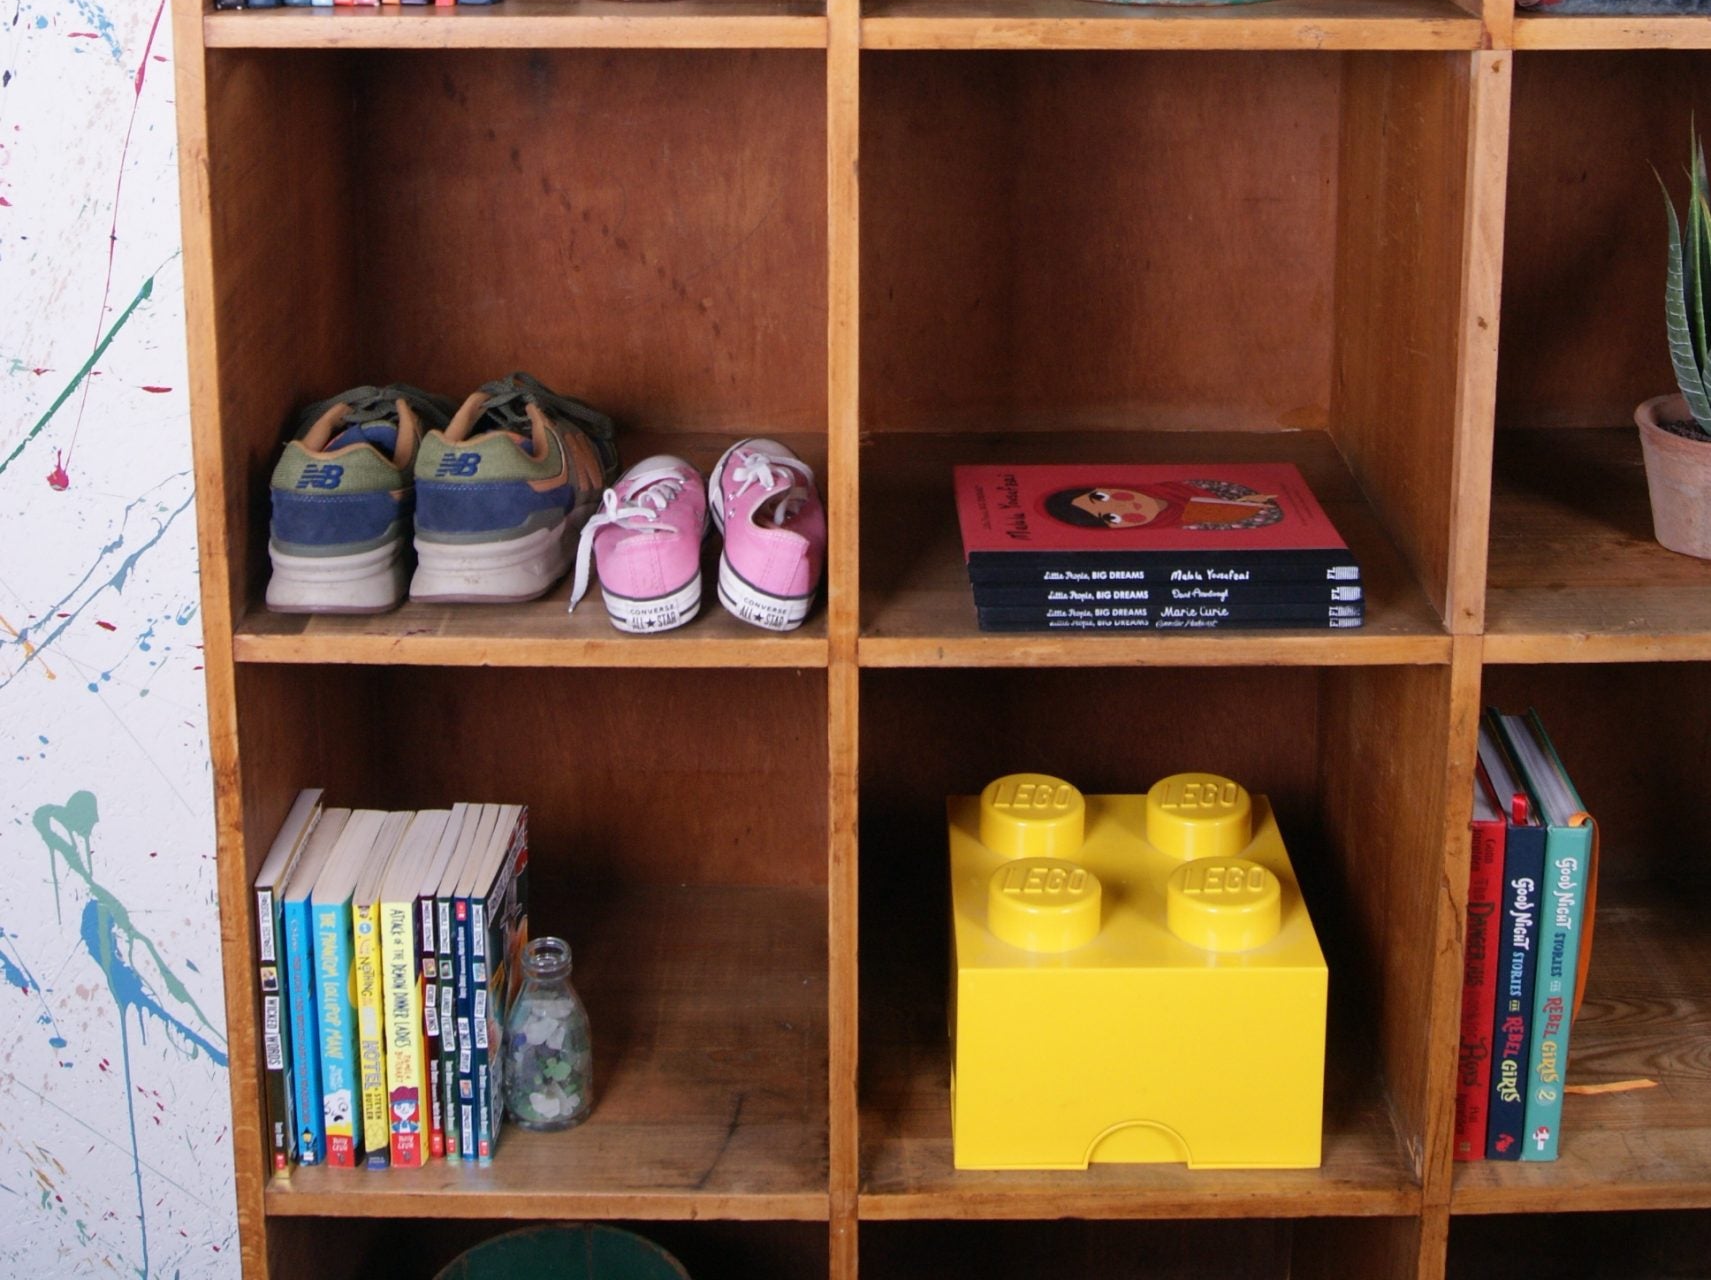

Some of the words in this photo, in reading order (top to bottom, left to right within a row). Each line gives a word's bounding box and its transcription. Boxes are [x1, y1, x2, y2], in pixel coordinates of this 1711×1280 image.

[1043, 571, 1064, 580] Little
[1092, 570, 1107, 580] BIG
[1109, 570, 1144, 580] DREAMS
[743, 597, 787, 615] CONVERSE
[1048, 591, 1068, 600] Little
[1096, 590, 1112, 600] BIG
[1113, 590, 1149, 600] DREAMS
[630, 603, 675, 615] CONVERSE
[632, 616, 644, 629] ALL
[656, 612, 678, 627] STAR
[739, 606, 752, 618] ALL
[764, 612, 784, 627] STAR
[1046, 608, 1067, 617] Little
[1094, 607, 1110, 617] BIG
[1112, 607, 1147, 617] DREAMS
[1160, 607, 1197, 617] Marie
[1199, 606, 1229, 617] Curie
[993, 783, 1073, 809] LEGO
[1160, 782, 1239, 809] LEGO
[1003, 867, 1089, 894] LEGO
[1183, 866, 1264, 894] LEGO
[319, 911, 337, 929] THE
[390, 909, 405, 935] ATTACK
[319, 932, 339, 978] PHANTOM
[1550, 933, 1566, 977] STORIES
[359, 956, 375, 997] NOTHING
[391, 963, 408, 989] DEMON
[1509, 951, 1525, 997] STORIES
[266, 999, 278, 1029] WICKED
[322, 982, 342, 1025] LOLLIPOP
[393, 992, 410, 1018] DINNER
[1542, 996, 1563, 1038] REBEL
[394, 1022, 411, 1048] LADIES
[1502, 1016, 1525, 1058] REBEL
[267, 1035, 281, 1066] WORDS
[362, 1040, 382, 1090] HOTEL
[365, 1093, 373, 1120] BUTLER
[374, 1092, 382, 1120] STEVEN
[1538, 1089, 1557, 1101] 2
